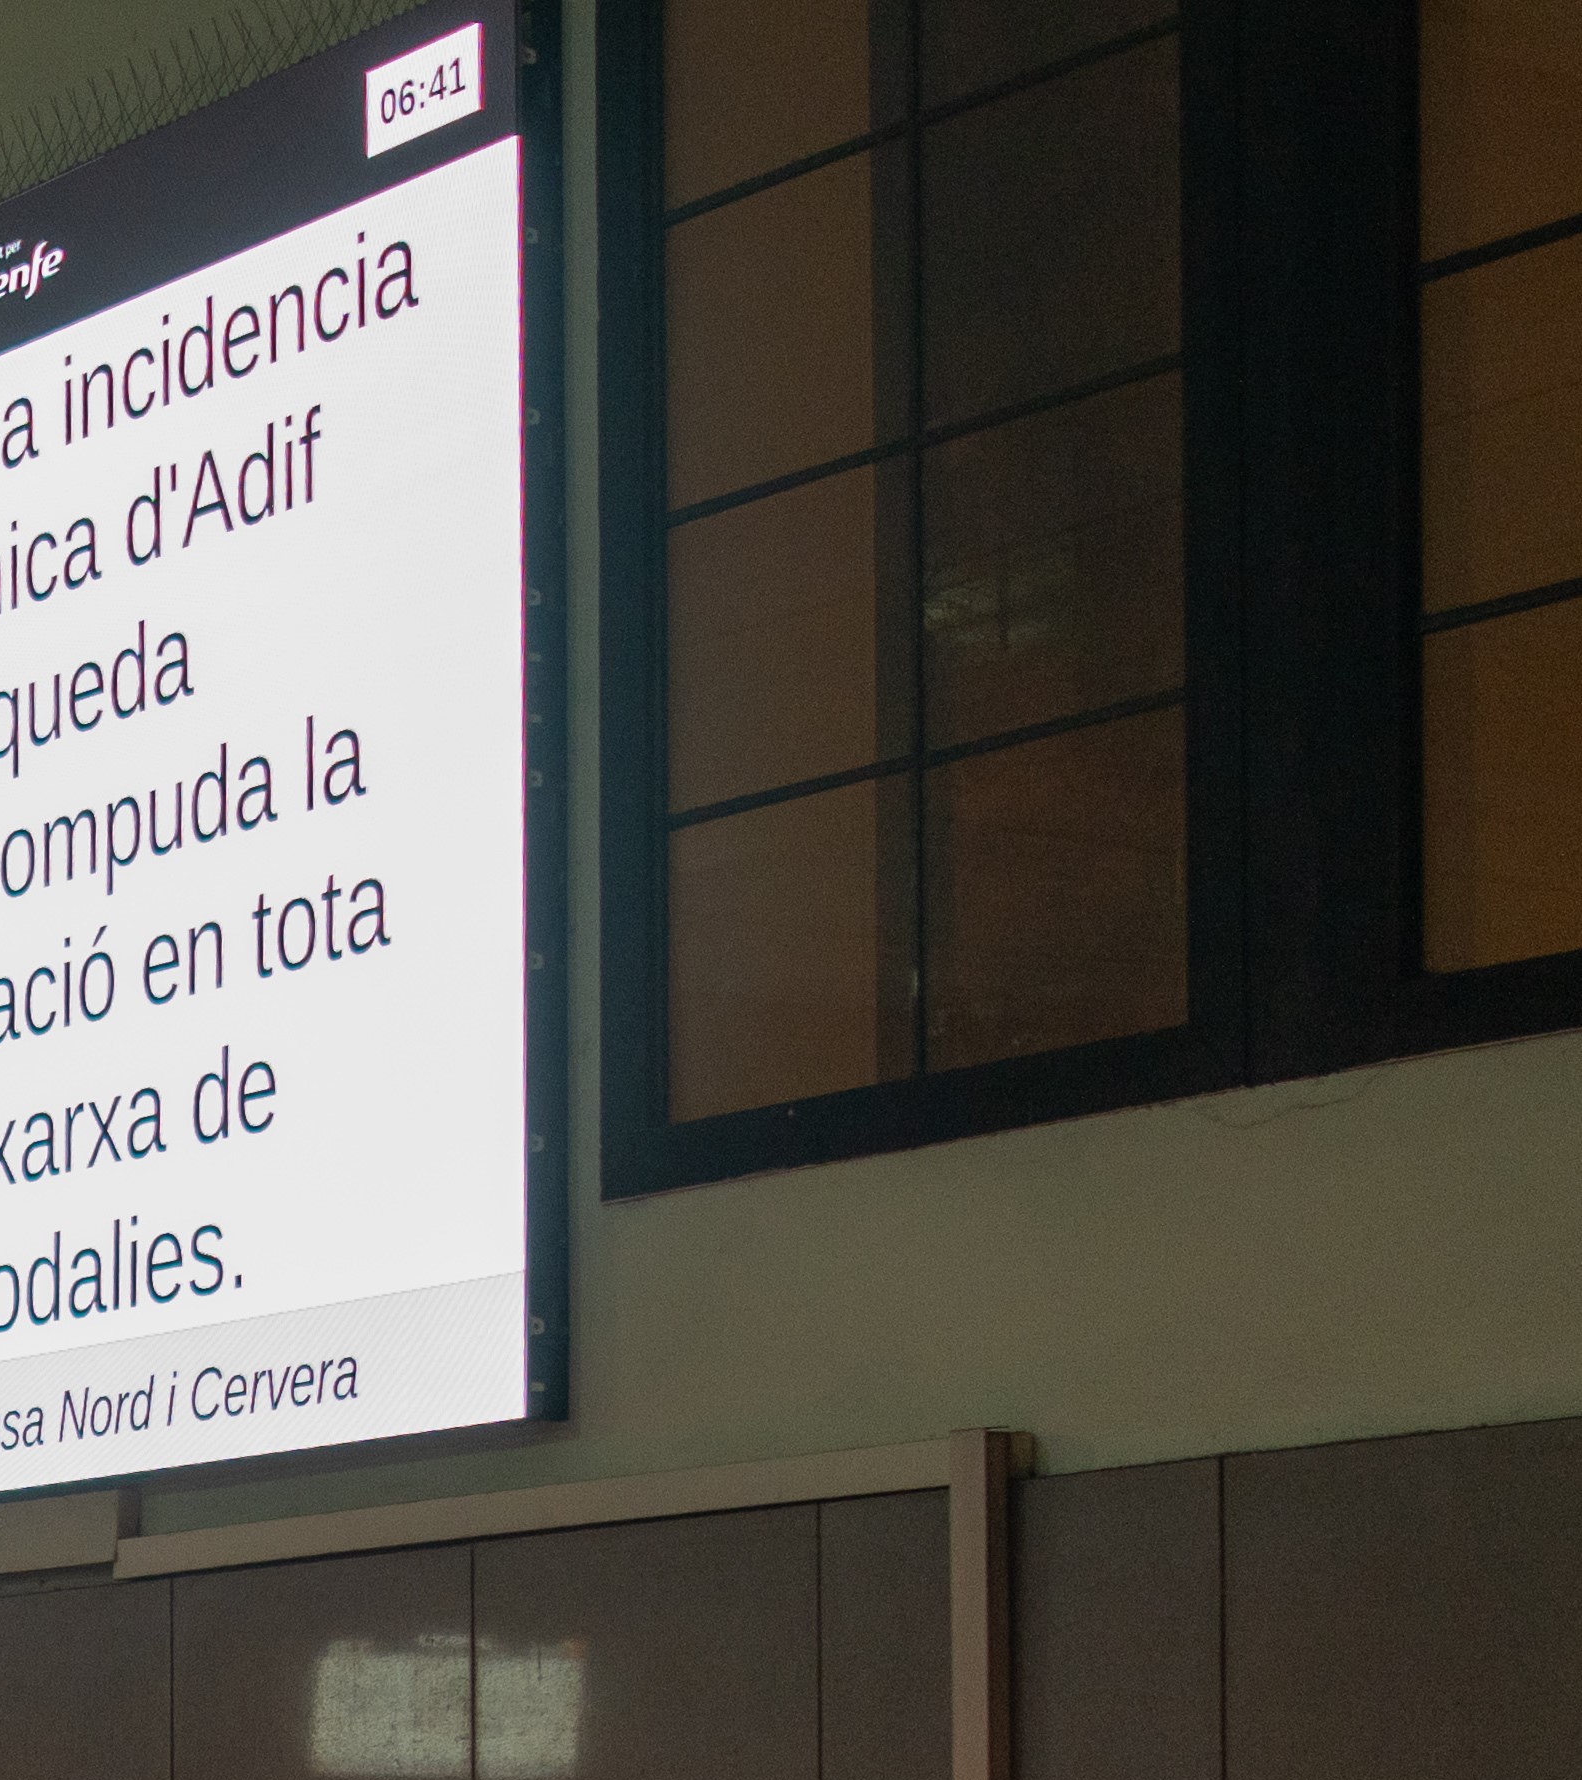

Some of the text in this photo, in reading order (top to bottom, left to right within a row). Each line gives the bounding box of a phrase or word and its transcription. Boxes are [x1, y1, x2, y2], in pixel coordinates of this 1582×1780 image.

[382, 58, 465, 123] 06:41
[4, 239, 23, 260] per
[66, 232, 418, 444] incidencia
[128, 404, 320, 565] d'Adif
[307, 716, 366, 810] la
[144, 922, 222, 1004] en
[253, 875, 390, 977] tota
[194, 1046, 275, 1143] de
[59, 1375, 154, 1442] Nord
[167, 1371, 177, 1425] i
[192, 1357, 357, 1420] Cervera
